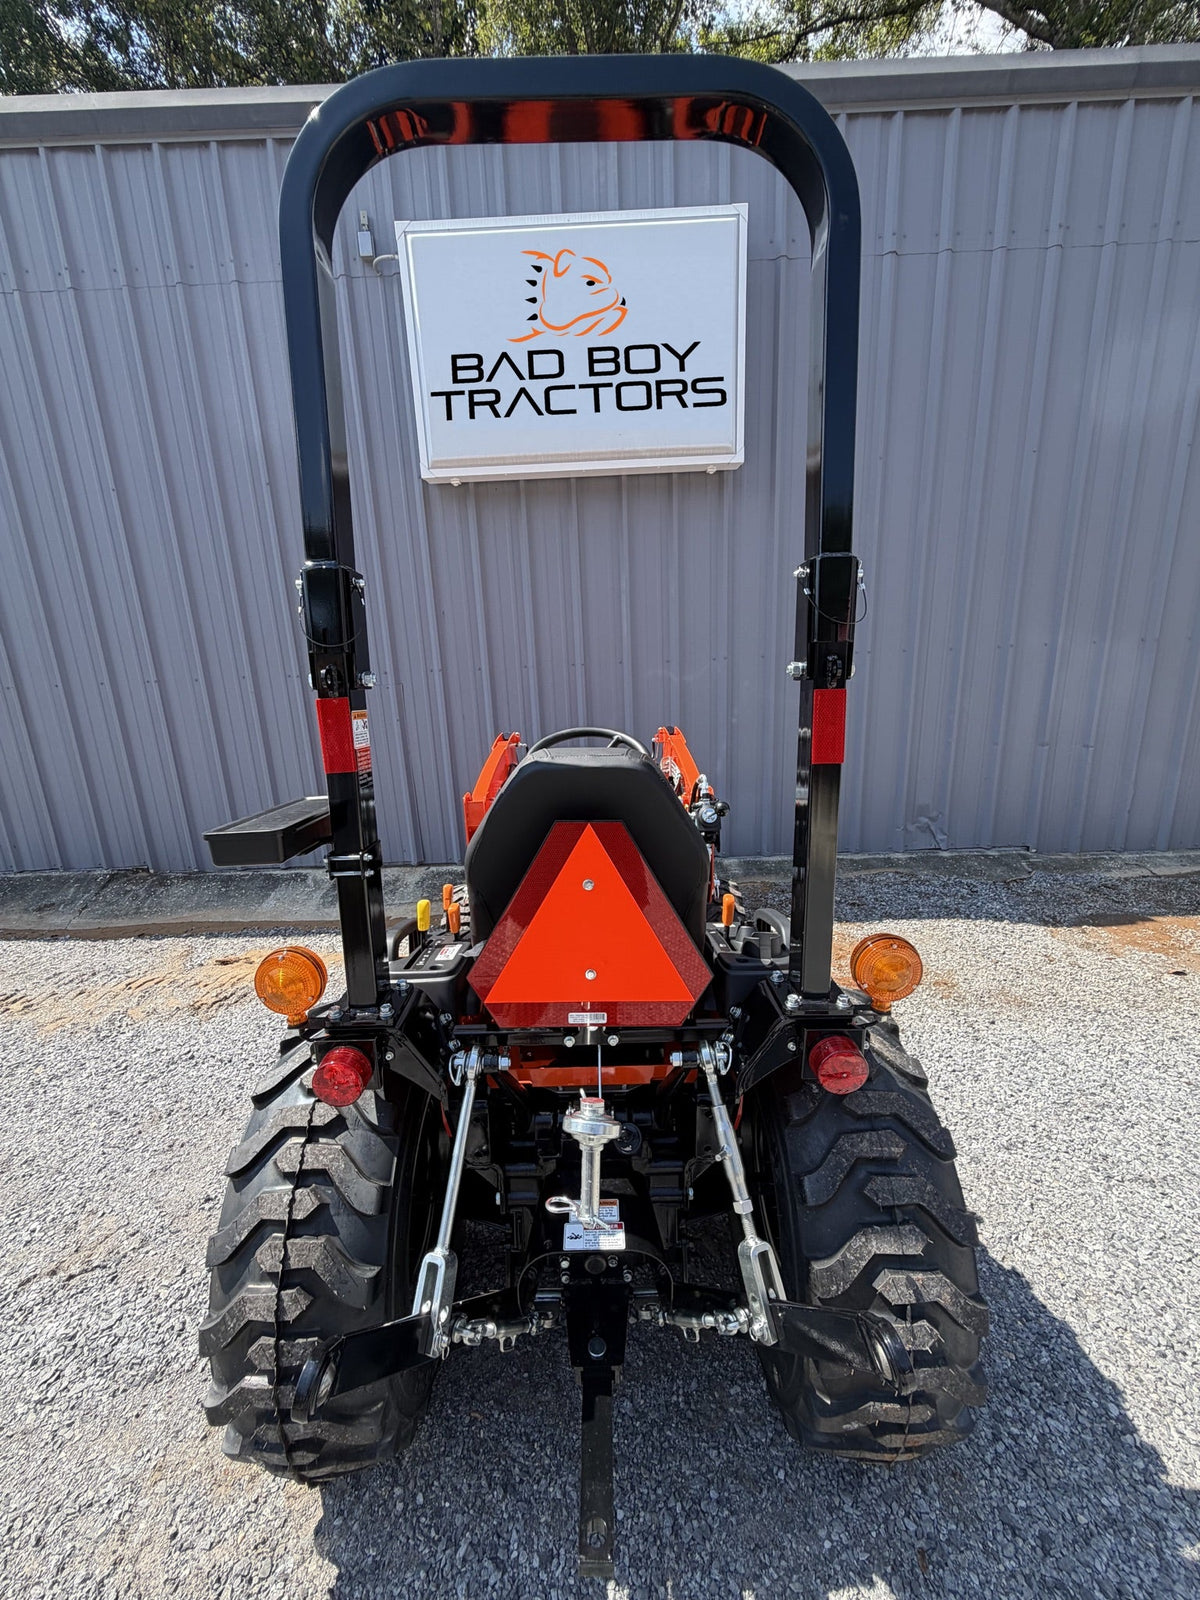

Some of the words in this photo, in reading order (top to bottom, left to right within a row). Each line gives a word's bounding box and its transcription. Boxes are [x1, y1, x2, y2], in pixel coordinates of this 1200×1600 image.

[451, 350, 564, 385] BAD
[588, 342, 701, 377] BOY
[431, 377, 728, 420] TRACTORS
